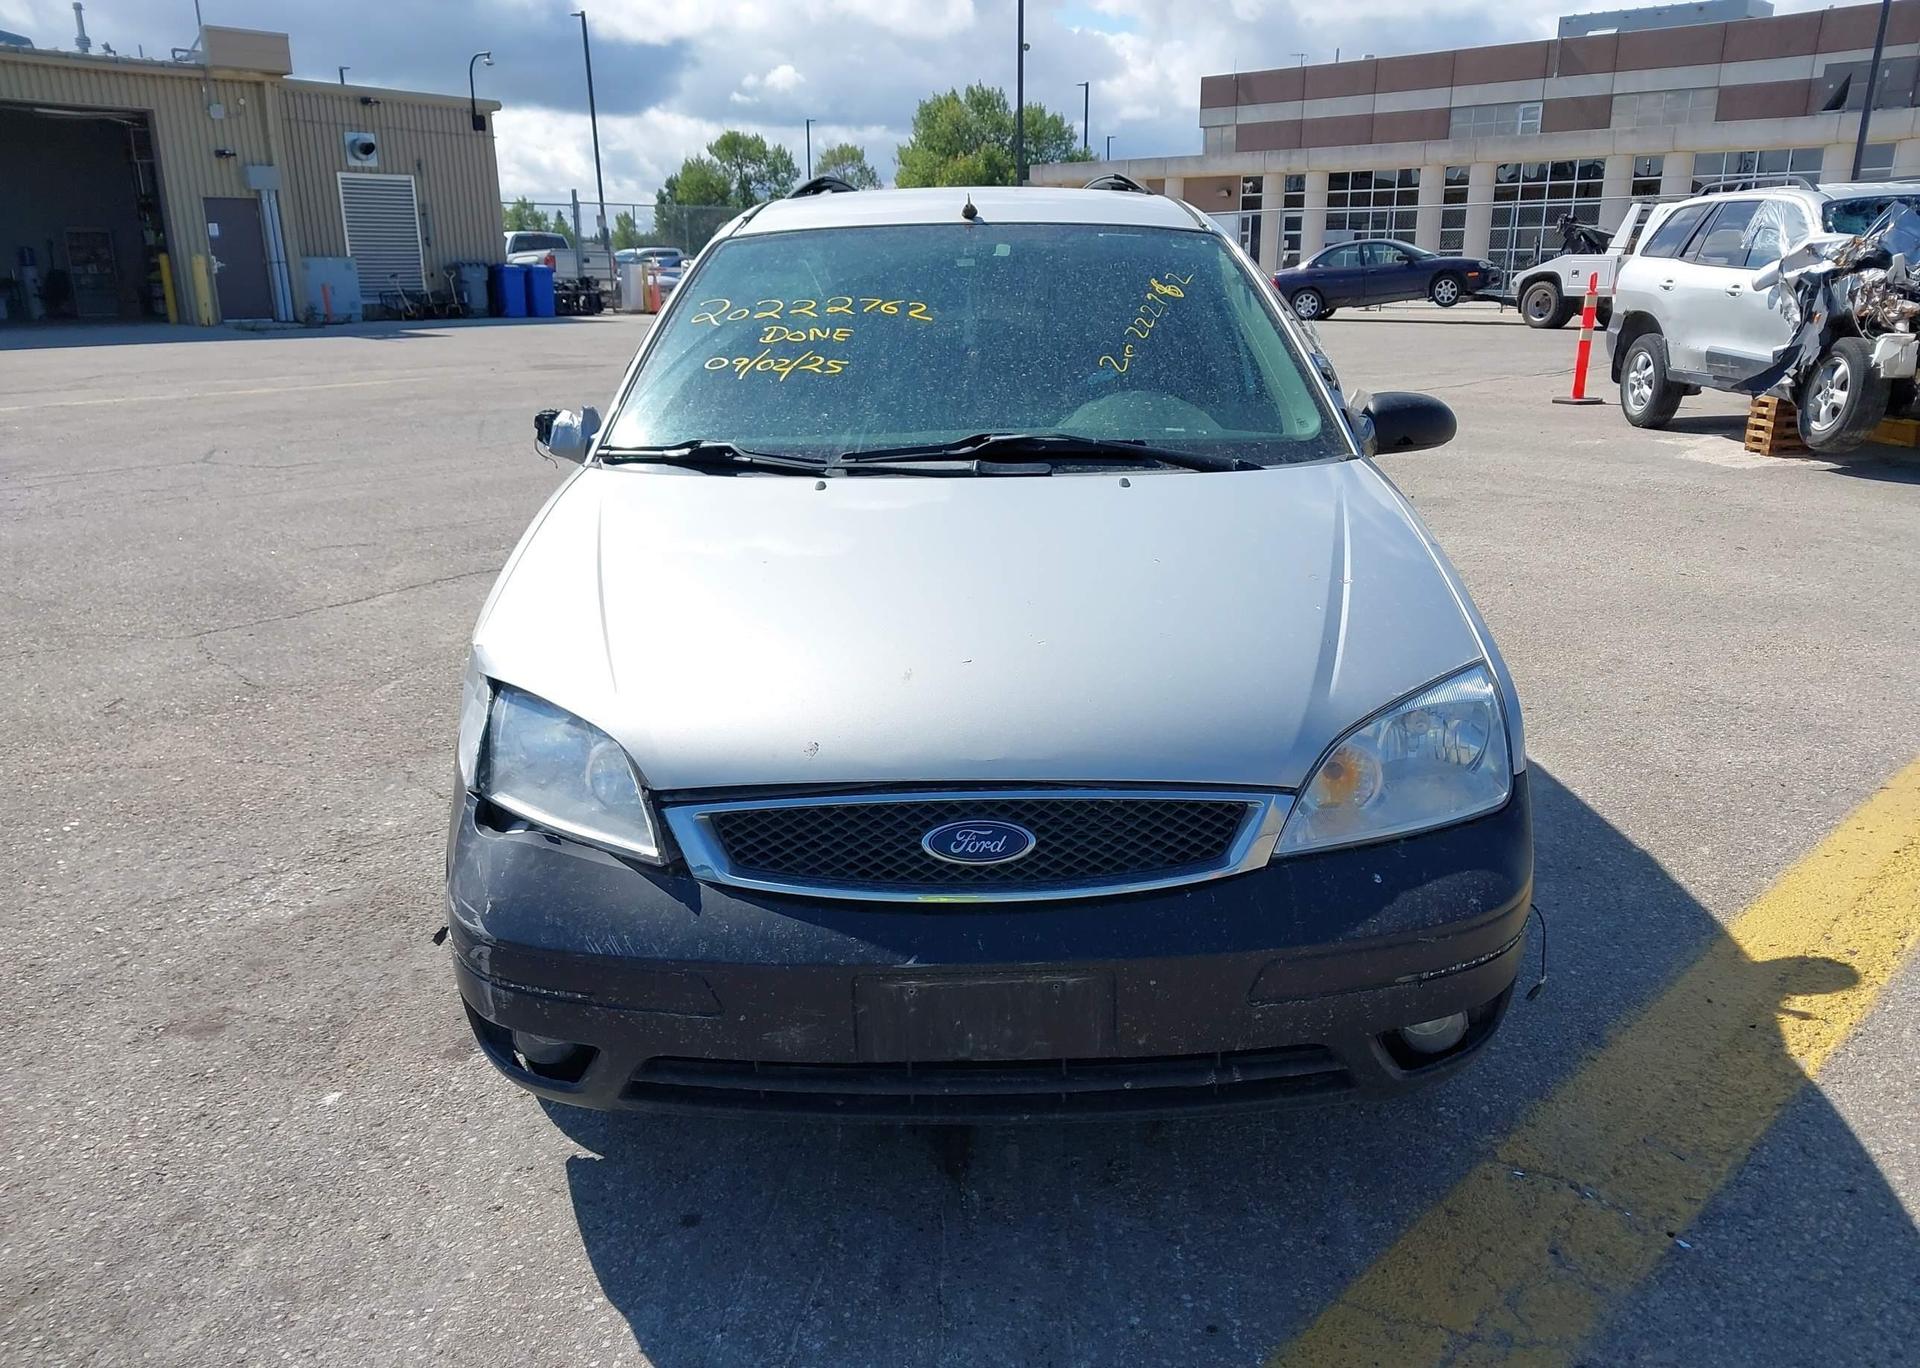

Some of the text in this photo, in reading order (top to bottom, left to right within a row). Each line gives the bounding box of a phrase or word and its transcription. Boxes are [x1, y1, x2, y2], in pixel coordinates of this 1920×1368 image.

[691, 297, 934, 327] 20222762
[758, 325, 855, 343] DONE
[703, 348, 850, 382] 09/02/25
[950, 829, 1007, 854] Ford
